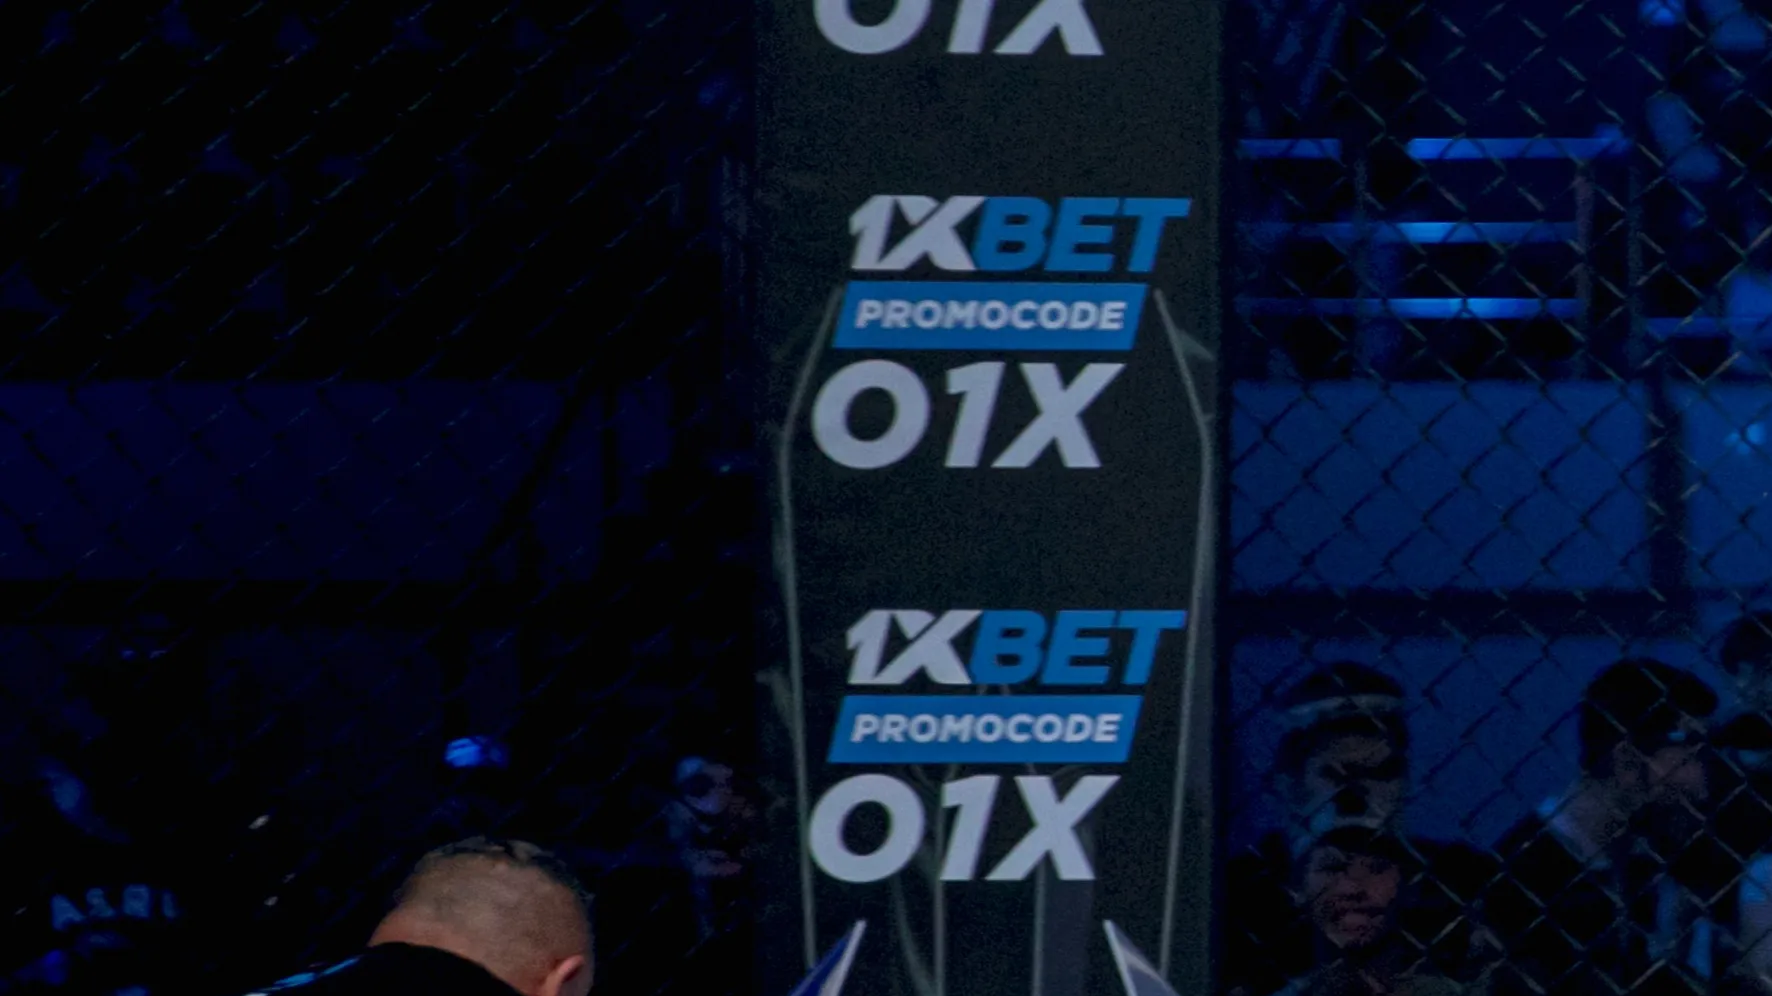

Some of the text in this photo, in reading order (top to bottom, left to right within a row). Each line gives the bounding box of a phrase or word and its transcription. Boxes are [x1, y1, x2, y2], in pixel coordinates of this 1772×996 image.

[849, 194, 1191, 272] 1XBET
[854, 298, 1128, 332] PROMOCODE
[845, 608, 1187, 685] 1XBET
[850, 712, 1122, 744] PROMOCODE
